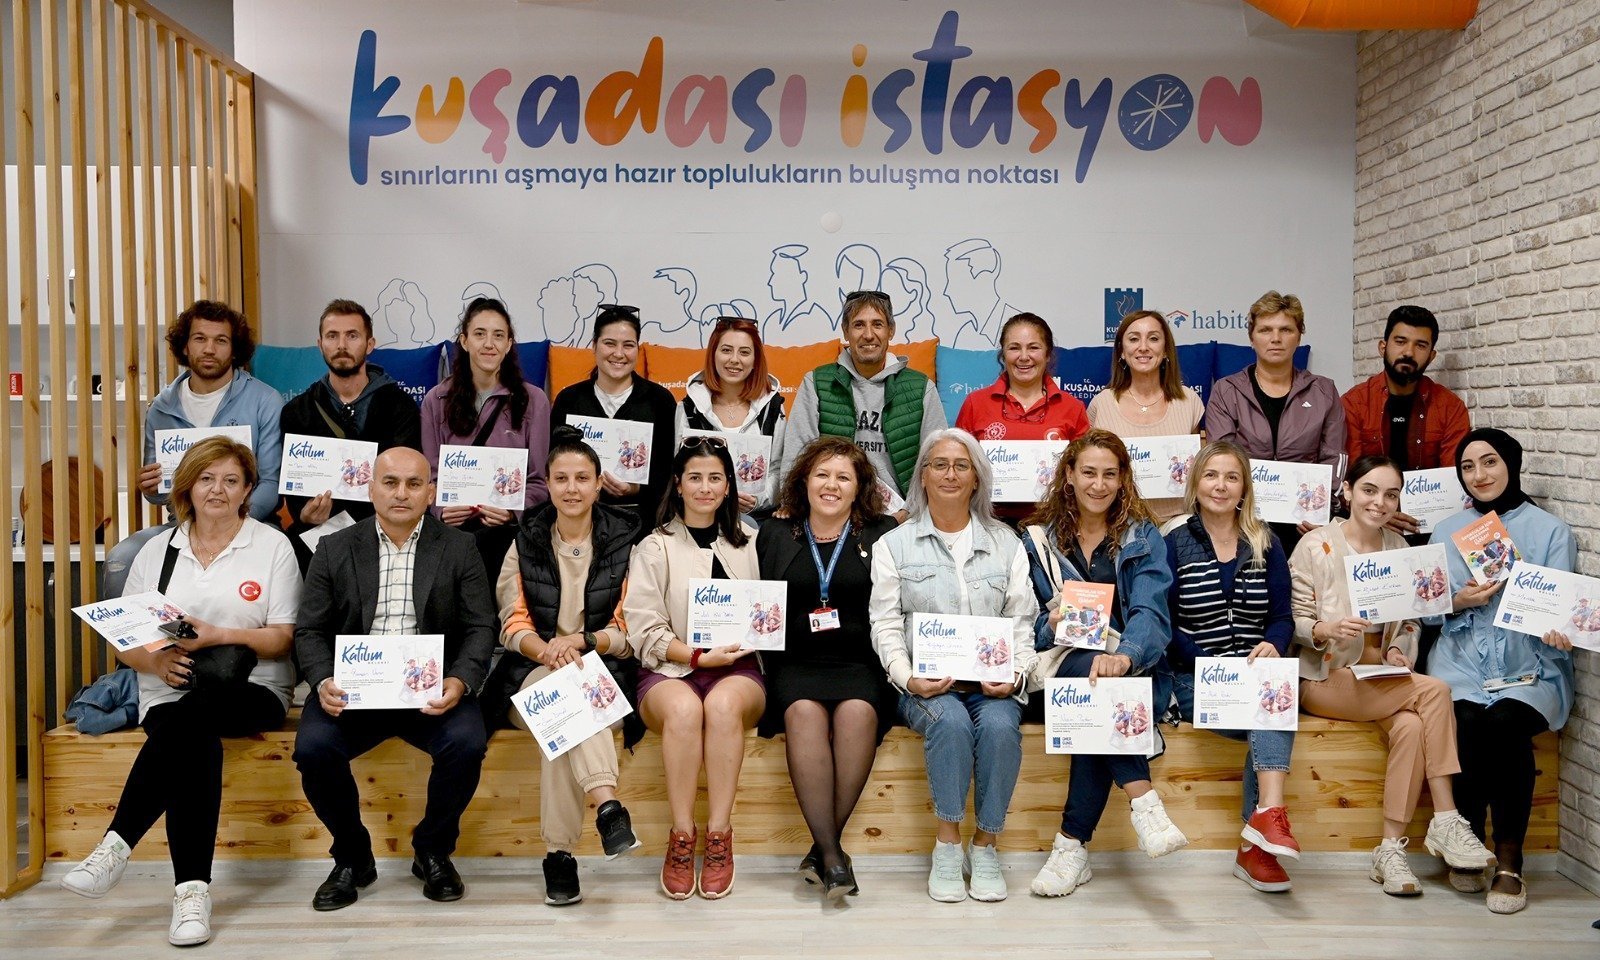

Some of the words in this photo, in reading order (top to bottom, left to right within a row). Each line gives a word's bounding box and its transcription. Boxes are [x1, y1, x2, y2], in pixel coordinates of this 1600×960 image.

[348, 29, 807, 186] kuşadası
[840, 10, 1263, 184] istasyon
[381, 166, 498, 186] sınırlarını
[504, 167, 609, 191] aşmaya
[615, 164, 676, 184] hazır
[682, 164, 842, 191] toplulukların
[849, 165, 960, 190] buluşma
[967, 166, 1060, 184] noktası
[1192, 310, 1251, 329] habita
[289, 441, 325, 459] Katılım
[444, 450, 478, 469] Katılım
[1405, 475, 1441, 496] Katılım
[1353, 558, 1392, 583] Katılım
[1514, 571, 1558, 593] Katılım
[694, 584, 732, 606] Katılım
[86, 606, 125, 622] Katılım
[918, 619, 956, 639] Katılım
[341, 641, 383, 665] Katılım
[1200, 663, 1239, 685] Katılım
[523, 689, 561, 717] Katılım
[1051, 684, 1091, 708] Katılım
